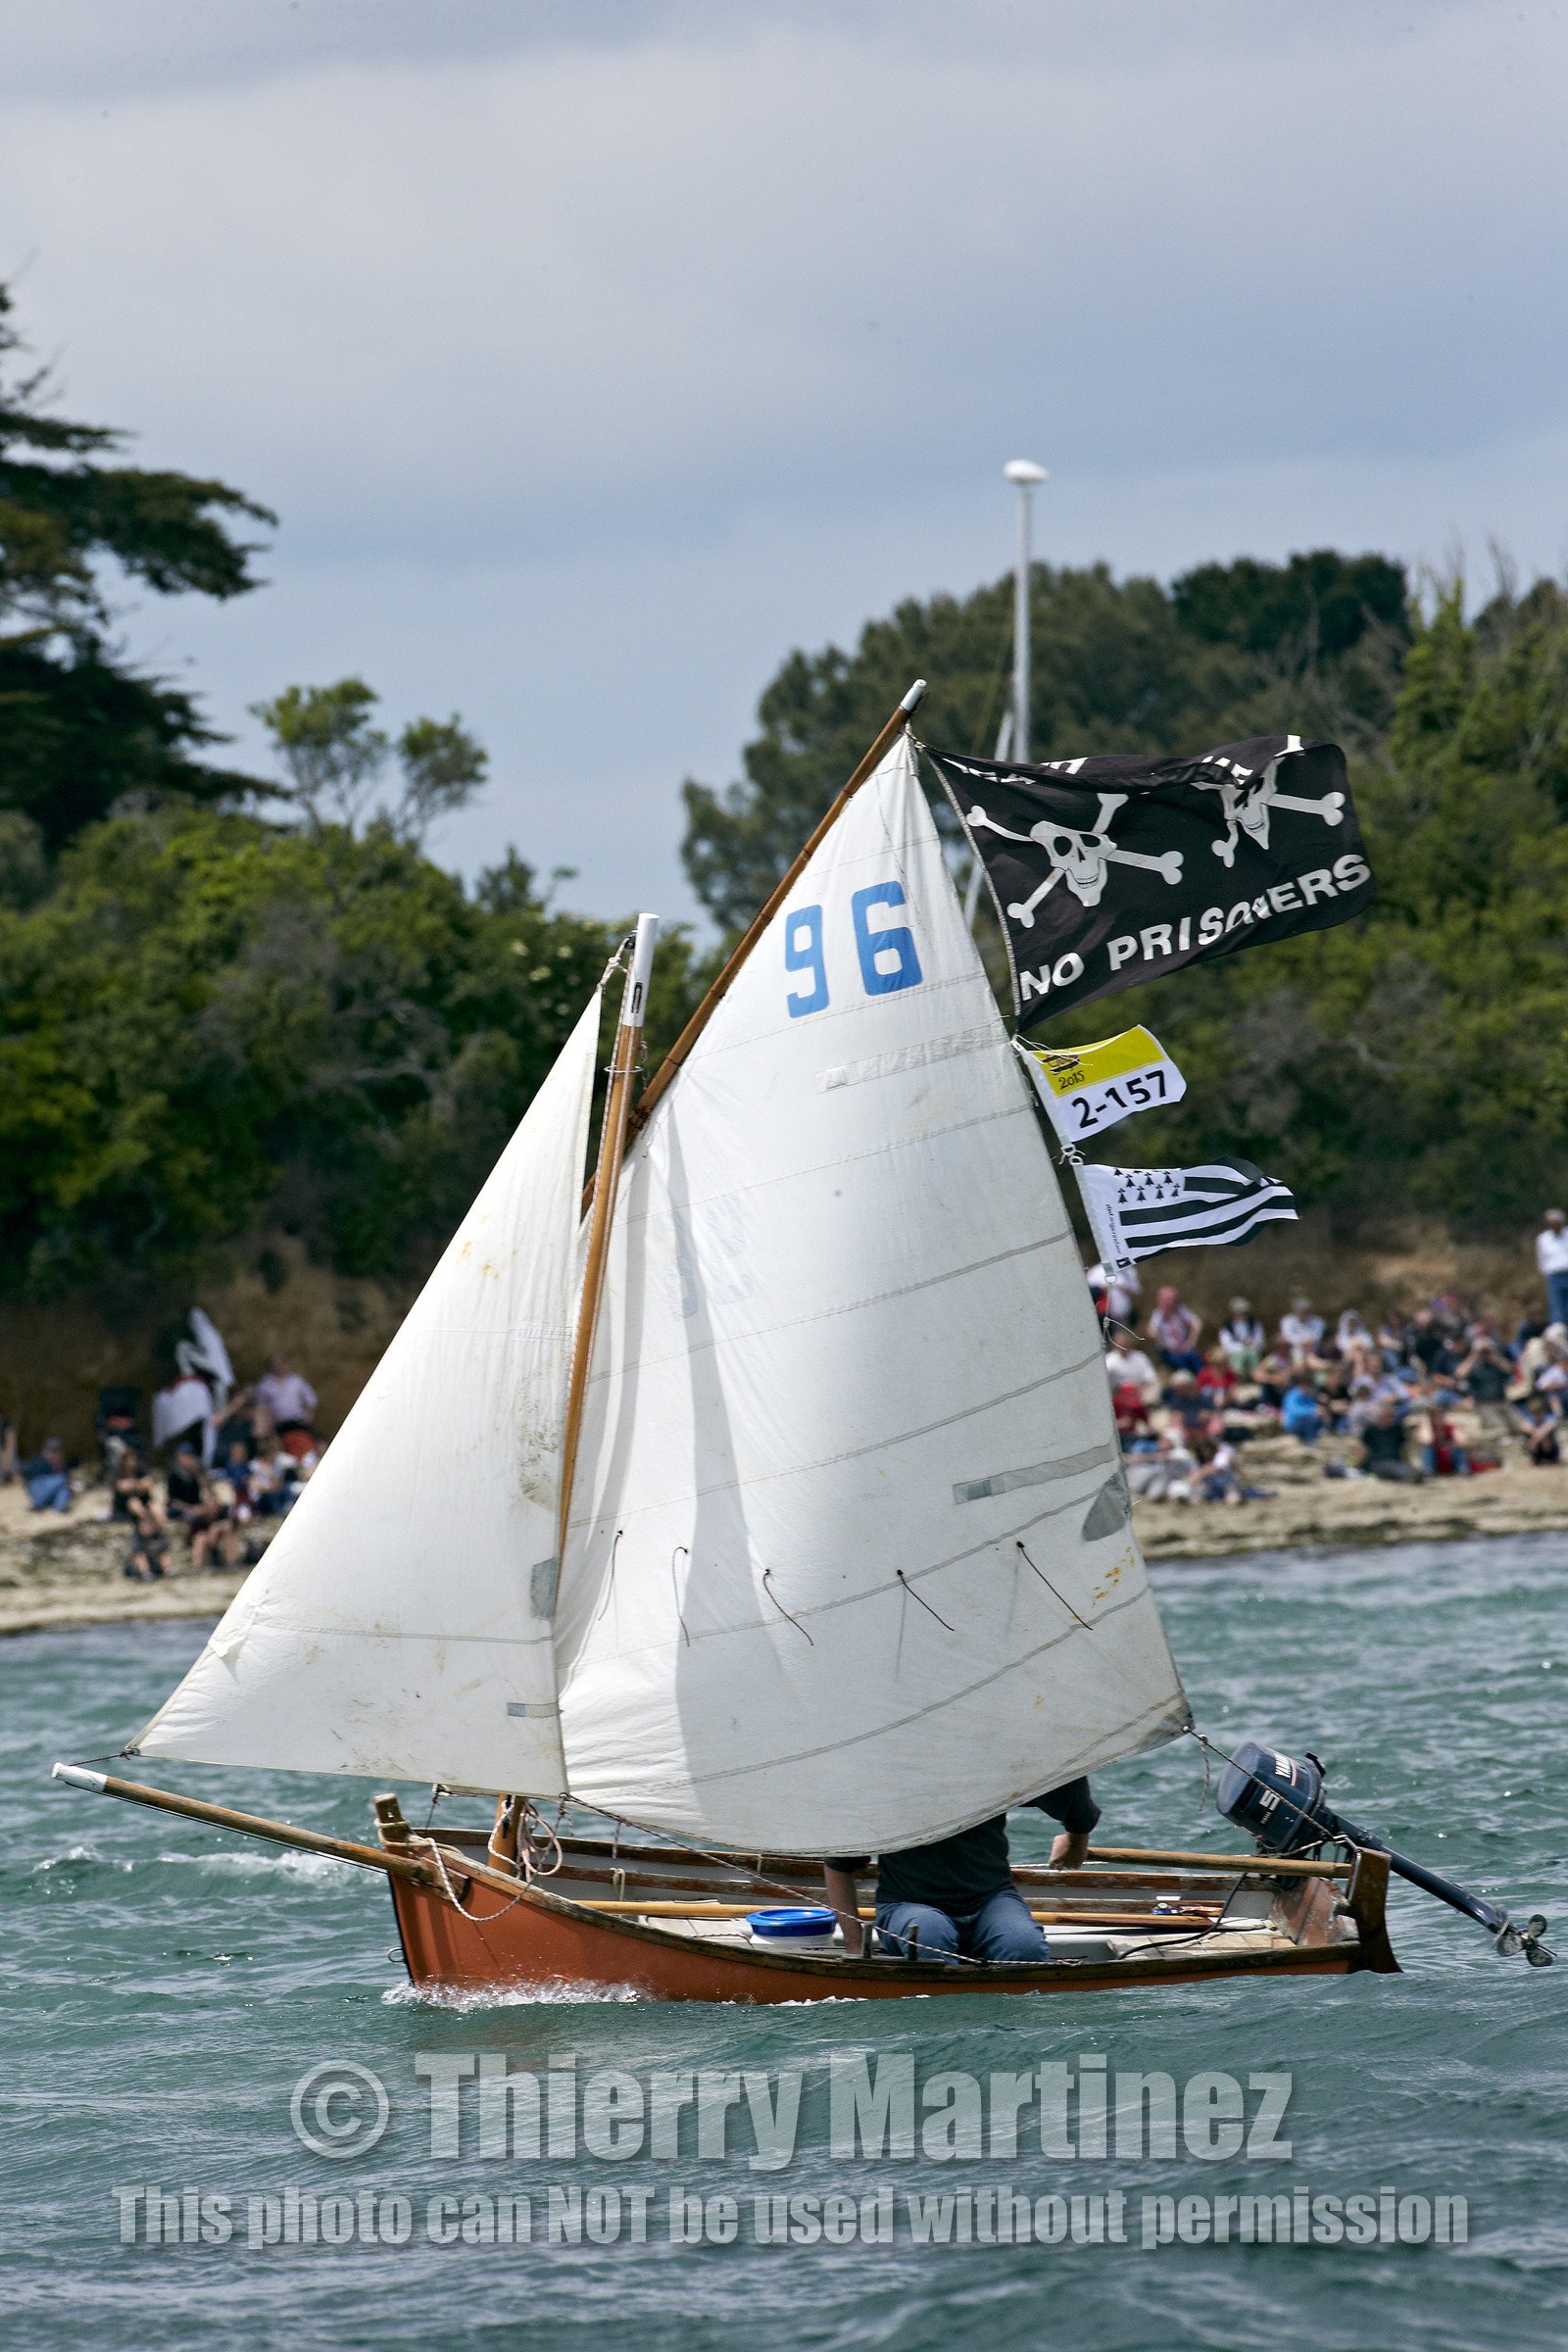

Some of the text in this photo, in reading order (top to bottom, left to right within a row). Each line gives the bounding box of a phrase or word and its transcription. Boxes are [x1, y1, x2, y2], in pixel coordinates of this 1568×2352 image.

[786, 880, 922, 1018] 96
[1019, 952, 1085, 1001] NO
[1058, 1070, 1085, 1090] 2015
[1071, 1069, 1167, 1129] 2-157
